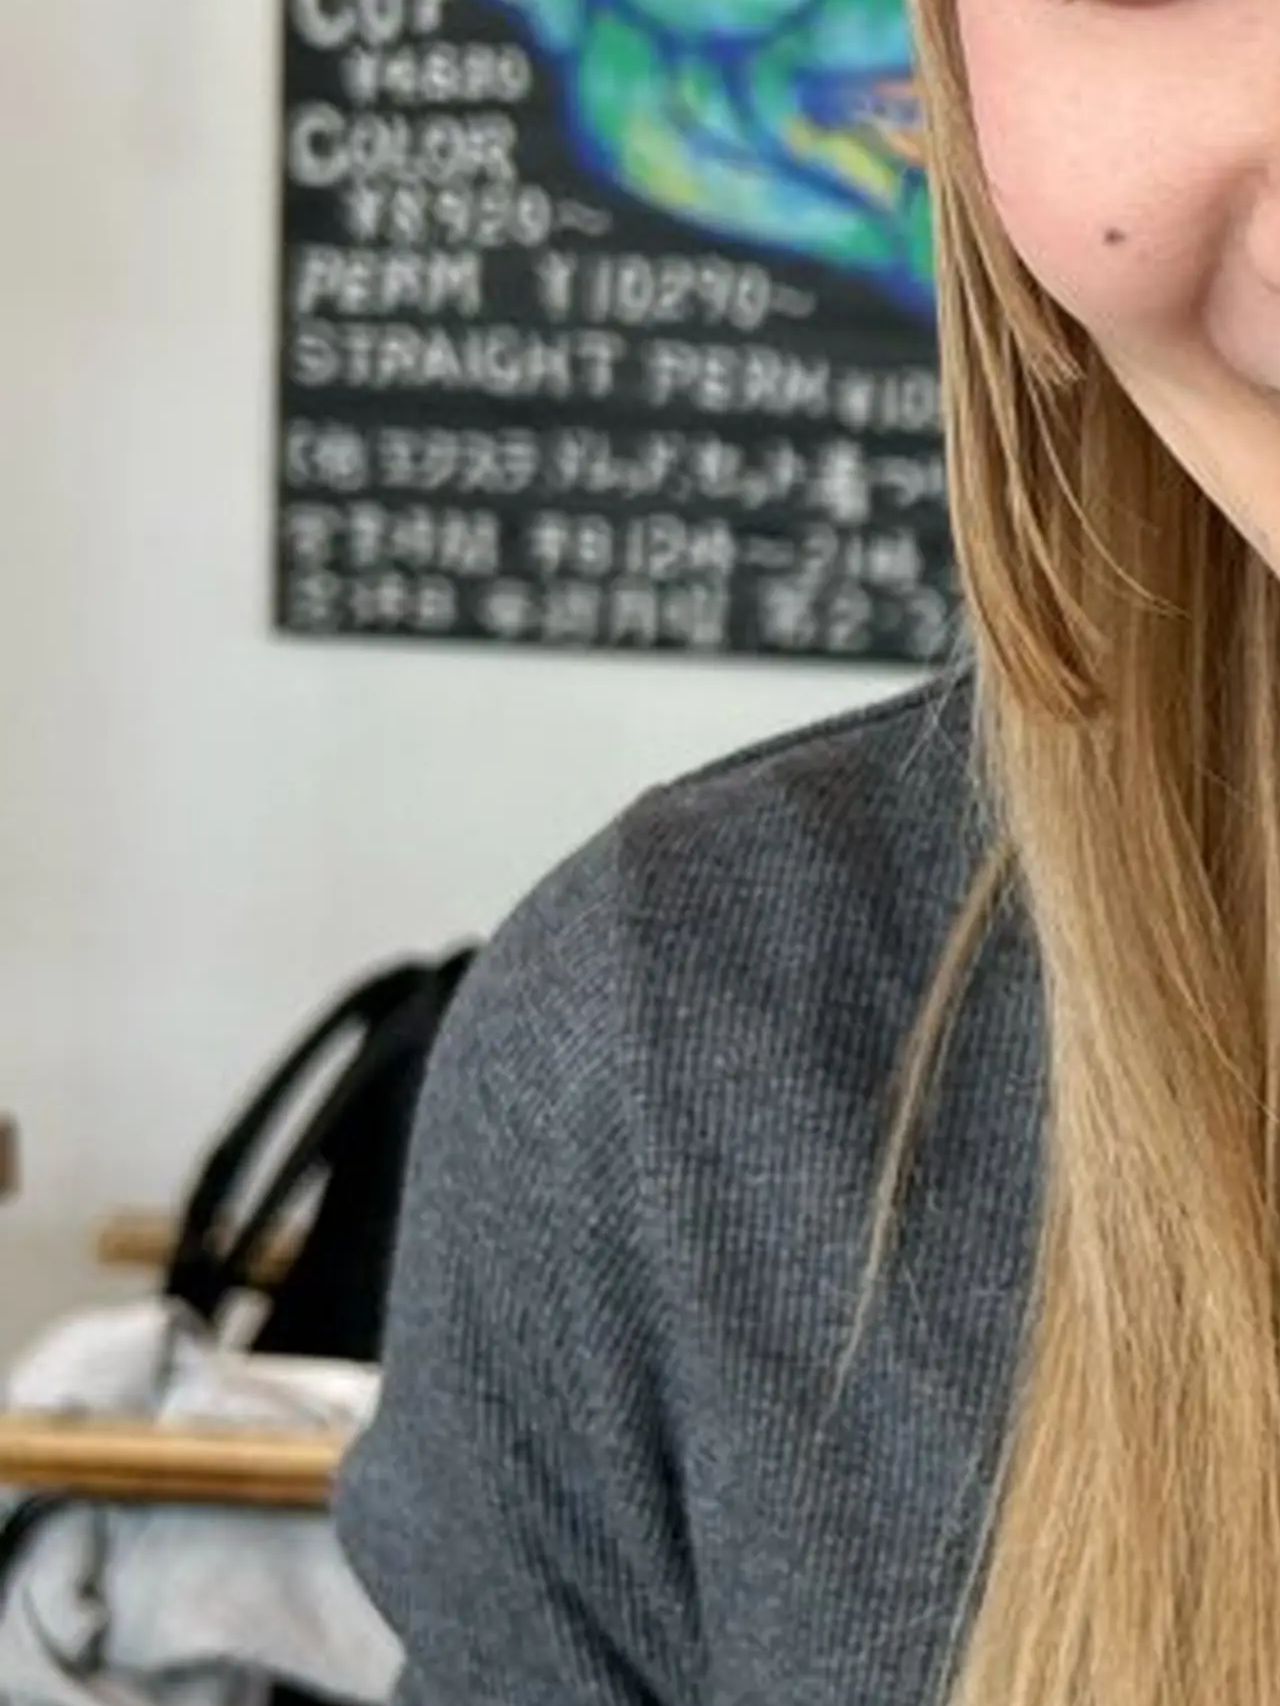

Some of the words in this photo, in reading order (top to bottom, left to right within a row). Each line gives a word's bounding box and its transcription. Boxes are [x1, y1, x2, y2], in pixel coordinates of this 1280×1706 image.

[297, 246, 483, 316] PERM
[292, 319, 624, 399] STRAIGHT
[643, 337, 832, 417] PERM
